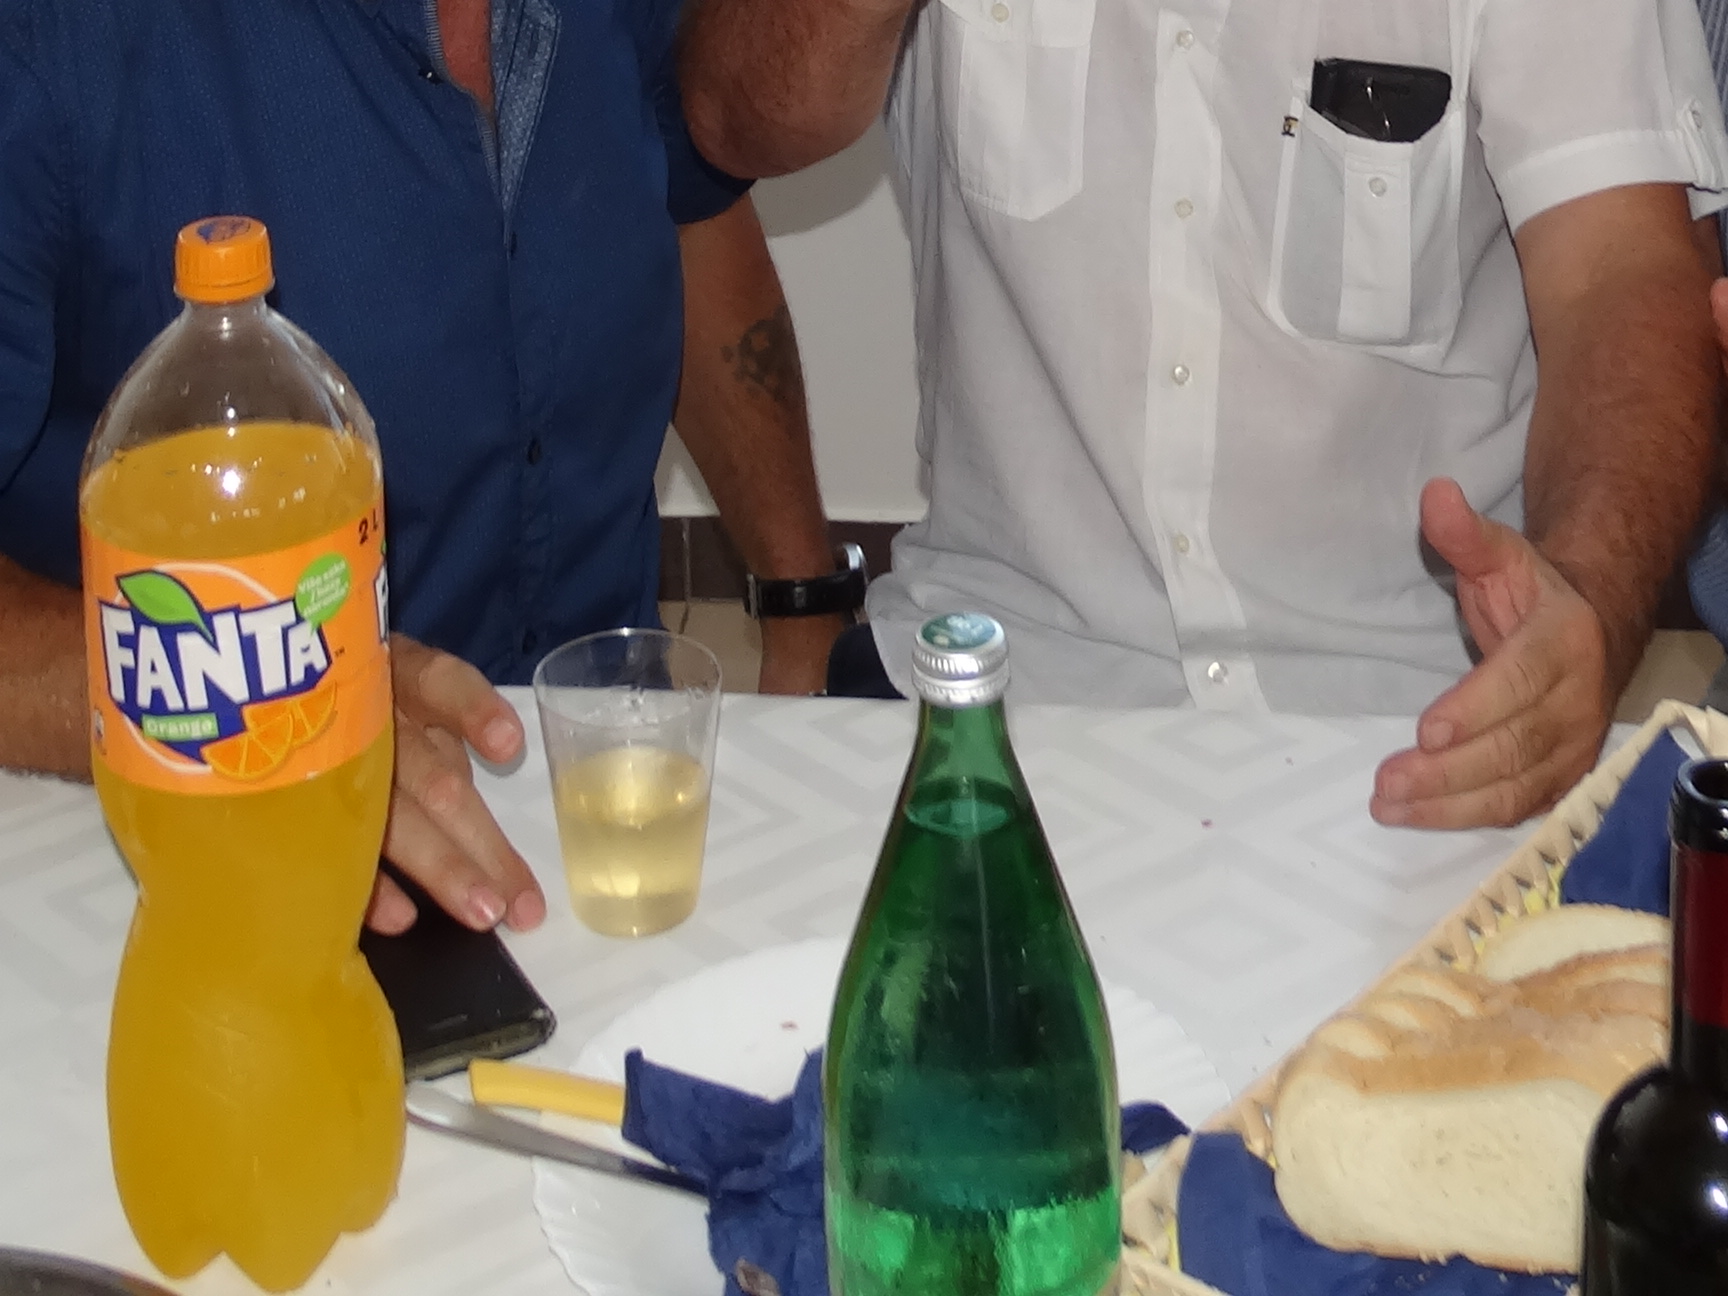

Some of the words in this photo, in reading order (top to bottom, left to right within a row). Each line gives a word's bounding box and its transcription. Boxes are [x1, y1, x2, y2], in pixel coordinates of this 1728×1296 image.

[358, 517, 369, 545] 2
[100, 599, 327, 711] FANTA
[145, 716, 214, 738] Orange
